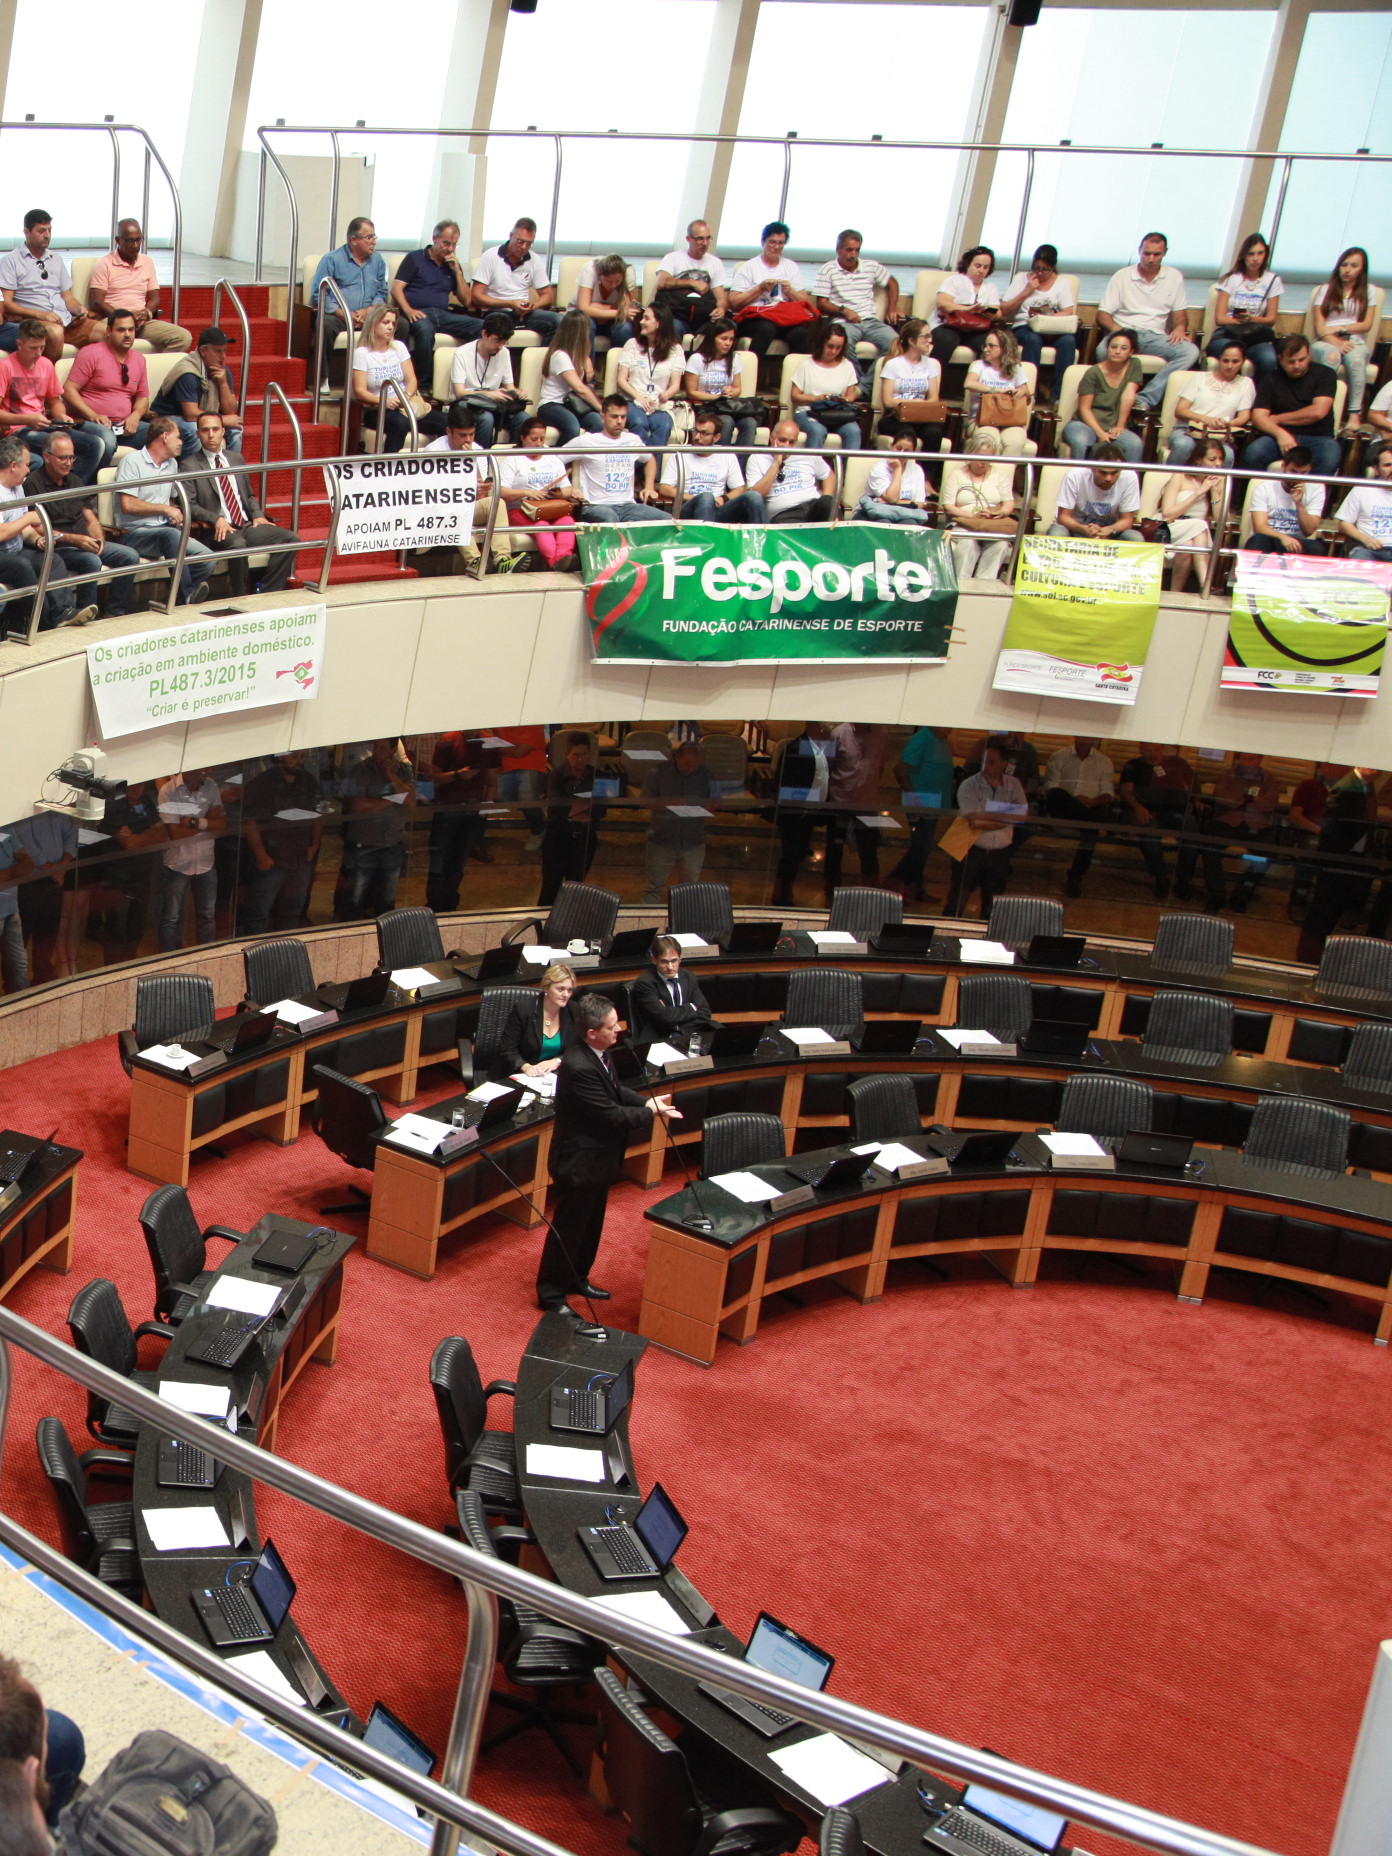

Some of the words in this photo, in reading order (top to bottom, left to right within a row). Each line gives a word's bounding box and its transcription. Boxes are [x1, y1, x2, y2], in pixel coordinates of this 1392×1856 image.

[360, 457, 474, 479] CRIADORES
[605, 472, 630, 483] 12%
[333, 487, 476, 511] ATARINENSES
[345, 521, 391, 535] APOIAM
[394, 518, 412, 531] PL
[416, 516, 458, 530] 487.3
[341, 539, 389, 553] AVIFAUNA
[392, 534, 460, 548] CATARINENSE
[661, 547, 933, 614] Fesporte
[662, 618, 737, 637] FUNDAÇÃO
[738, 618, 829, 632] CATARINENSE
[833, 618, 853, 631] DE
[857, 619, 924, 632] ESPORTE
[94, 647, 113, 663] Os
[117, 635, 177, 659] criadores
[180, 621, 265, 646] catarinenses
[269, 613, 317, 633] apoiam
[93, 673, 100, 686] a
[105, 660, 152, 685] criação
[156, 658, 175, 674] em
[178, 645, 238, 668] ambiente
[242, 632, 316, 656] doméstico.
[149, 661, 257, 699] PL487.3/2015
[1048, 665, 1087, 677] FESPORTE
[1257, 670, 1275, 680] FCC
[181, 698, 189, 711] é
